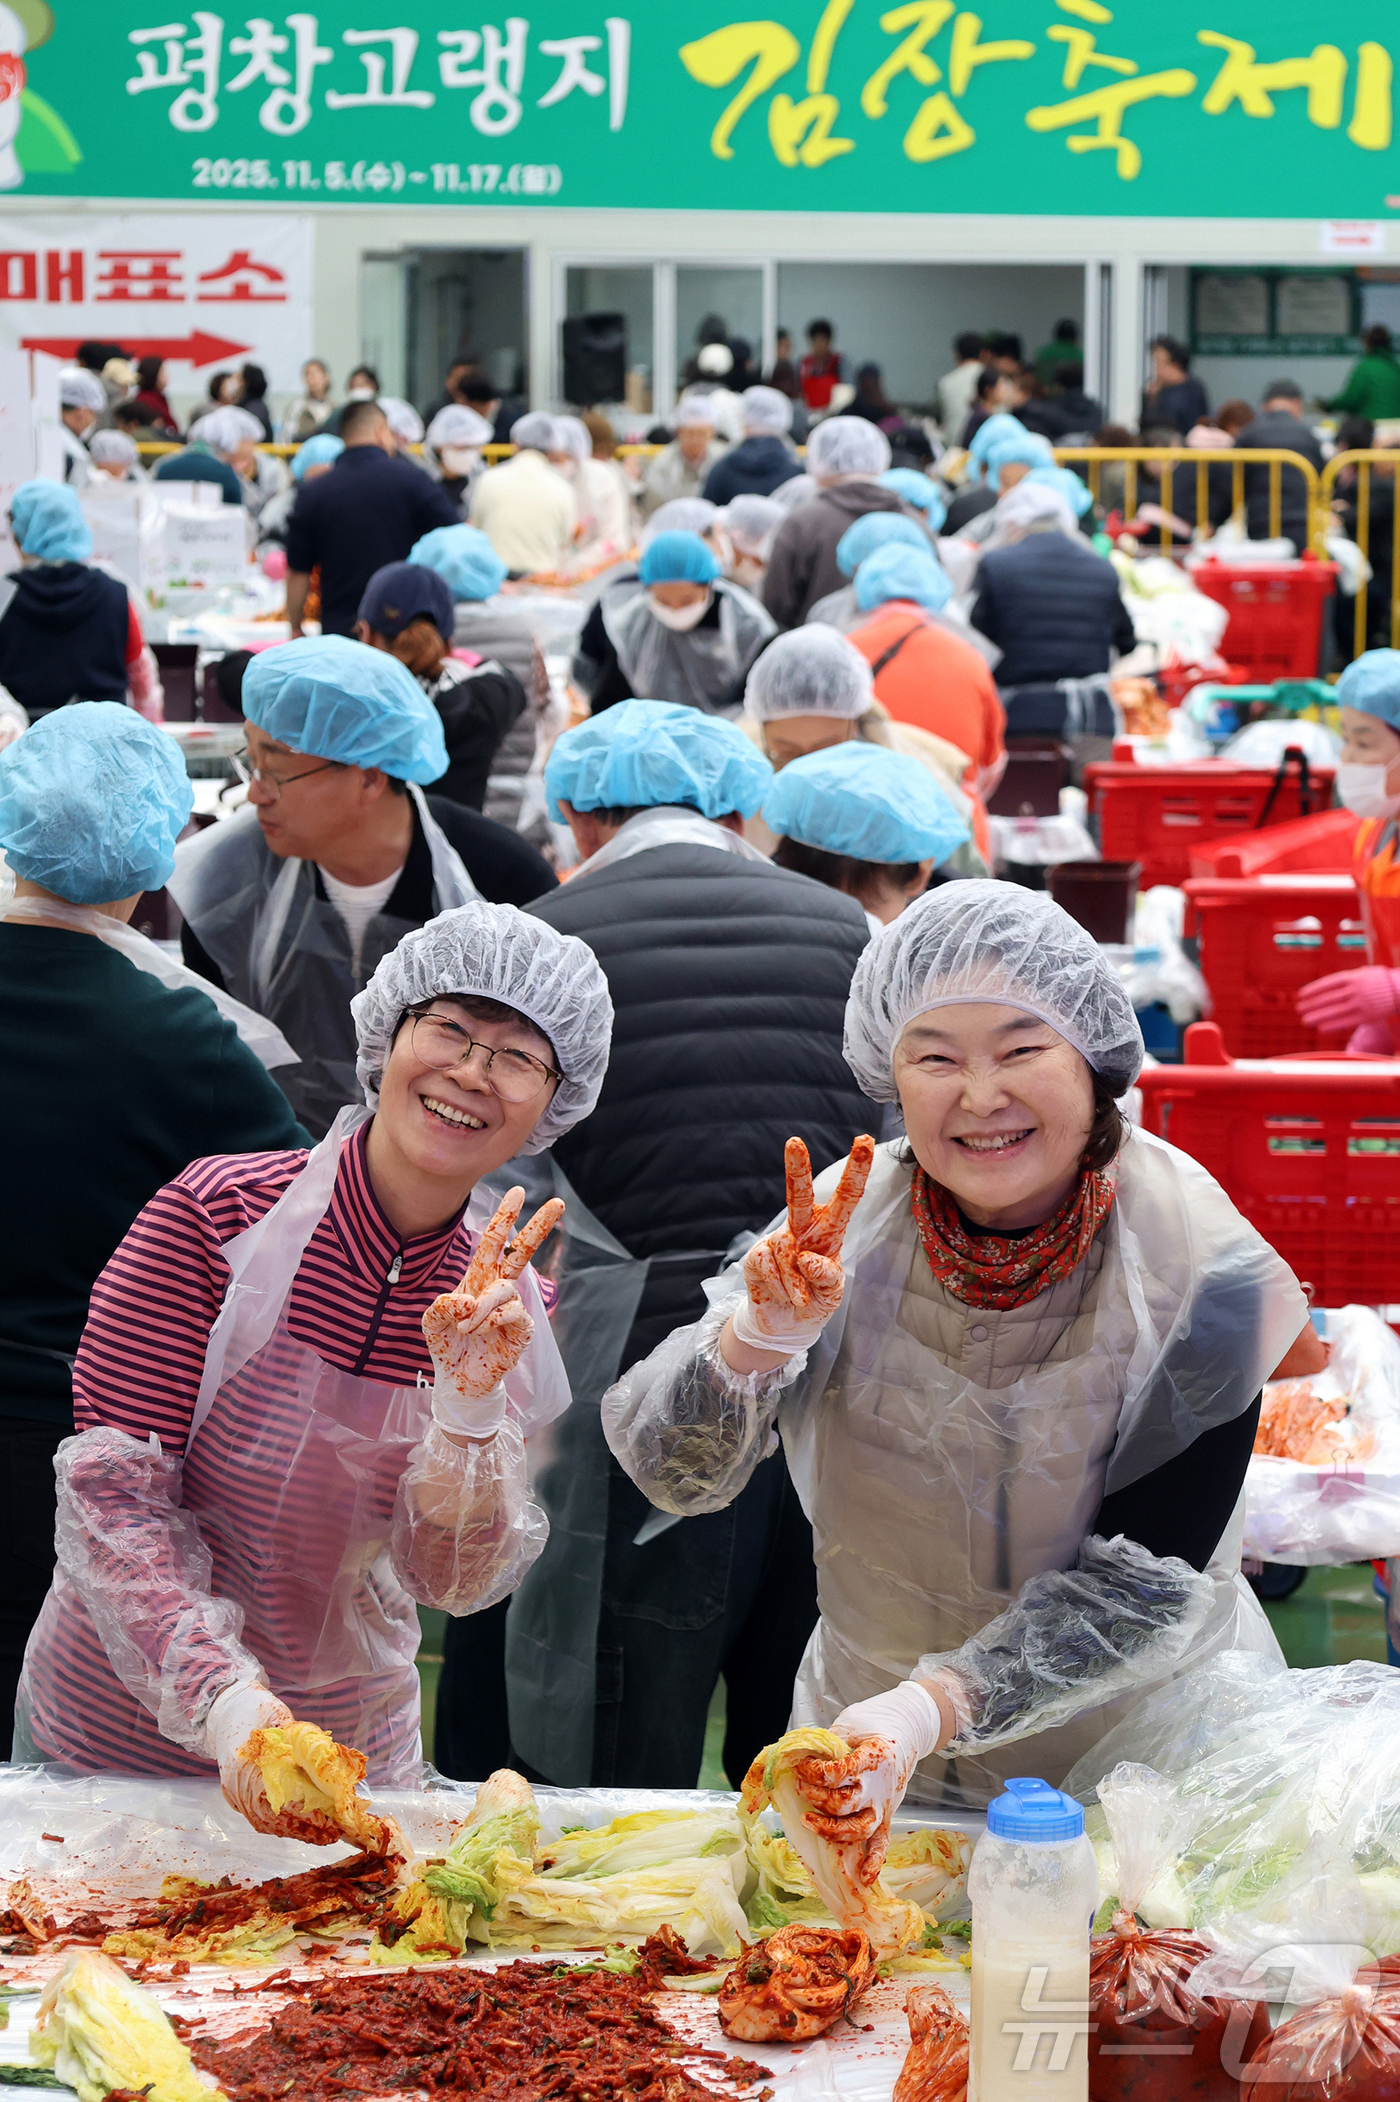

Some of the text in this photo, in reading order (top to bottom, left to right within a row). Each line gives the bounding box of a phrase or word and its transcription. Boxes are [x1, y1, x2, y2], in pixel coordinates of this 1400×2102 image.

[125, 0, 1394, 181] 평창고랭지 김장축제
[0, 249, 289, 302] 매표소
